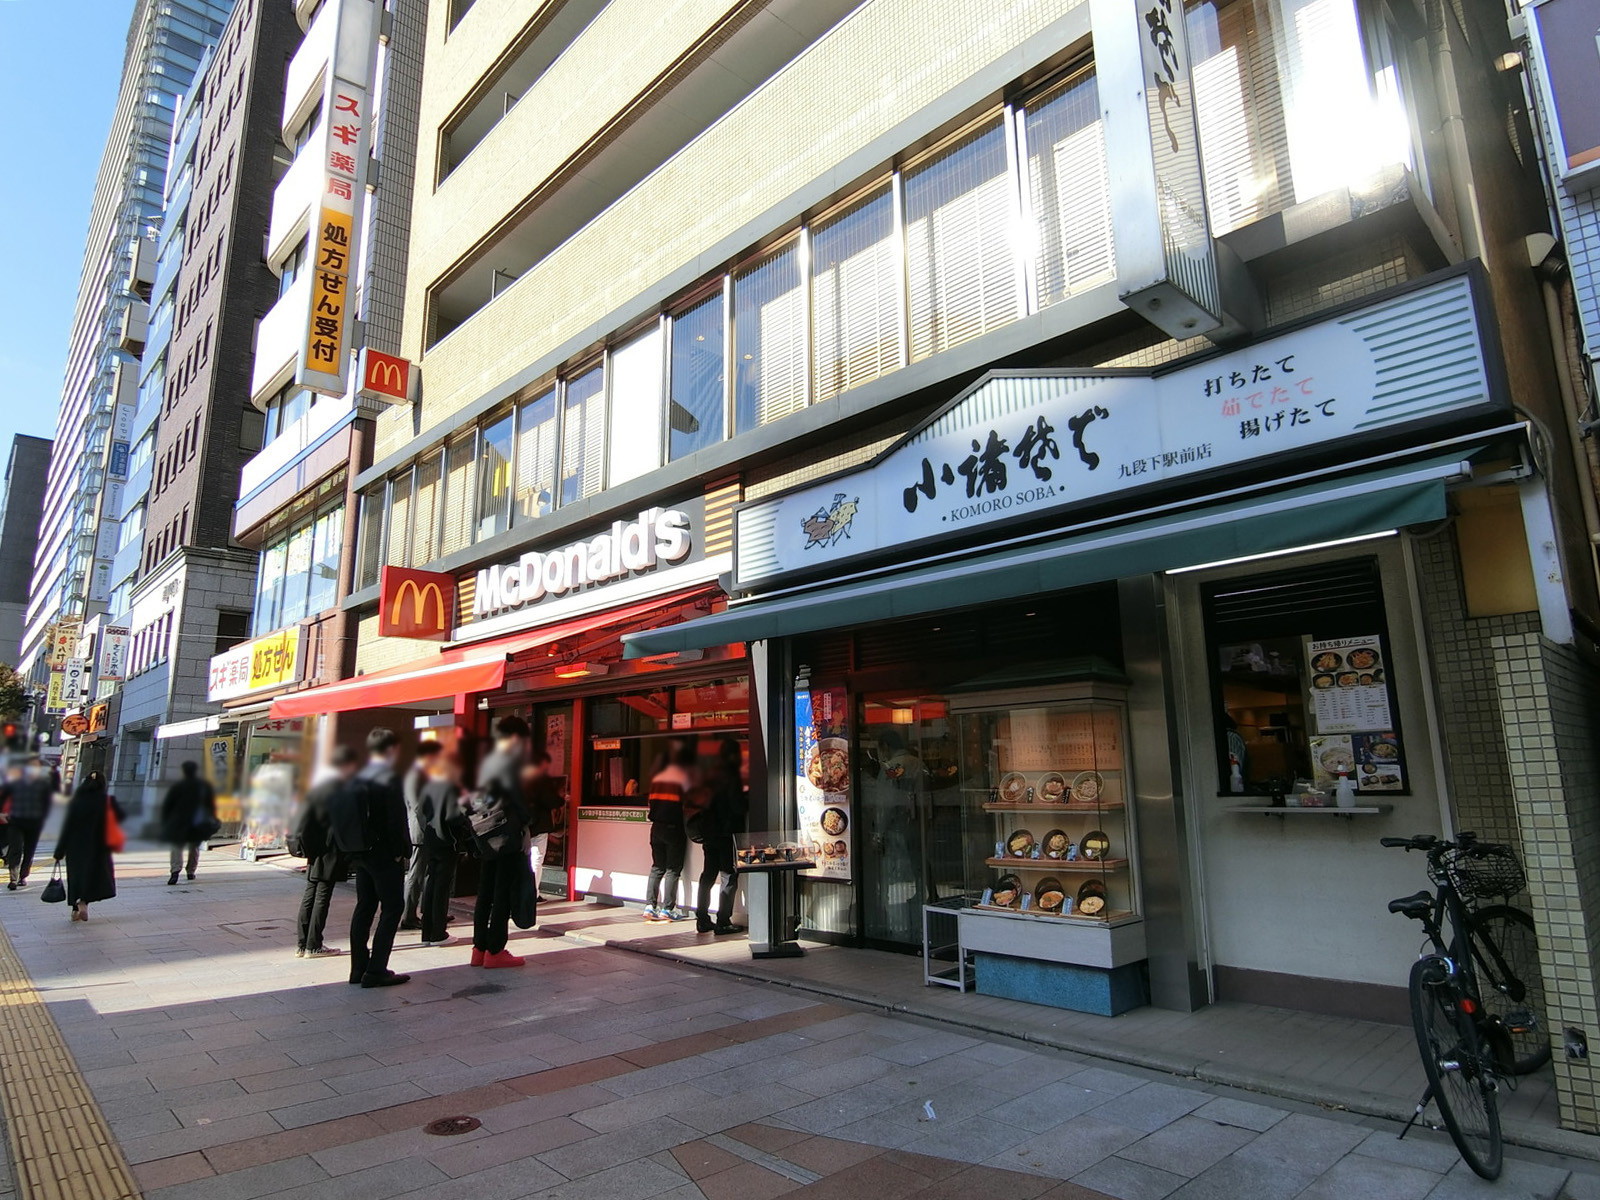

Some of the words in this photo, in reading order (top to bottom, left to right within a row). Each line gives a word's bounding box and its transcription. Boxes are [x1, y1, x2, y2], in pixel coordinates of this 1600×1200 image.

[327, 94, 361, 201] スギ薬局
[312, 222, 348, 363] 処方せん受付
[1204, 355, 1296, 397] 打ちたて
[1221, 377, 1315, 417] 茹でたて
[1240, 398, 1337, 439] 揚げたて
[1117, 443, 1212, 480] 九段下駅前店
[950, 495, 1013, 522] KOMORO
[1015, 485, 1057, 506] SOBA
[472, 506, 691, 617] McDonald's
[208, 656, 249, 692] スギ薬局
[252, 640, 294, 681] 処方せん
